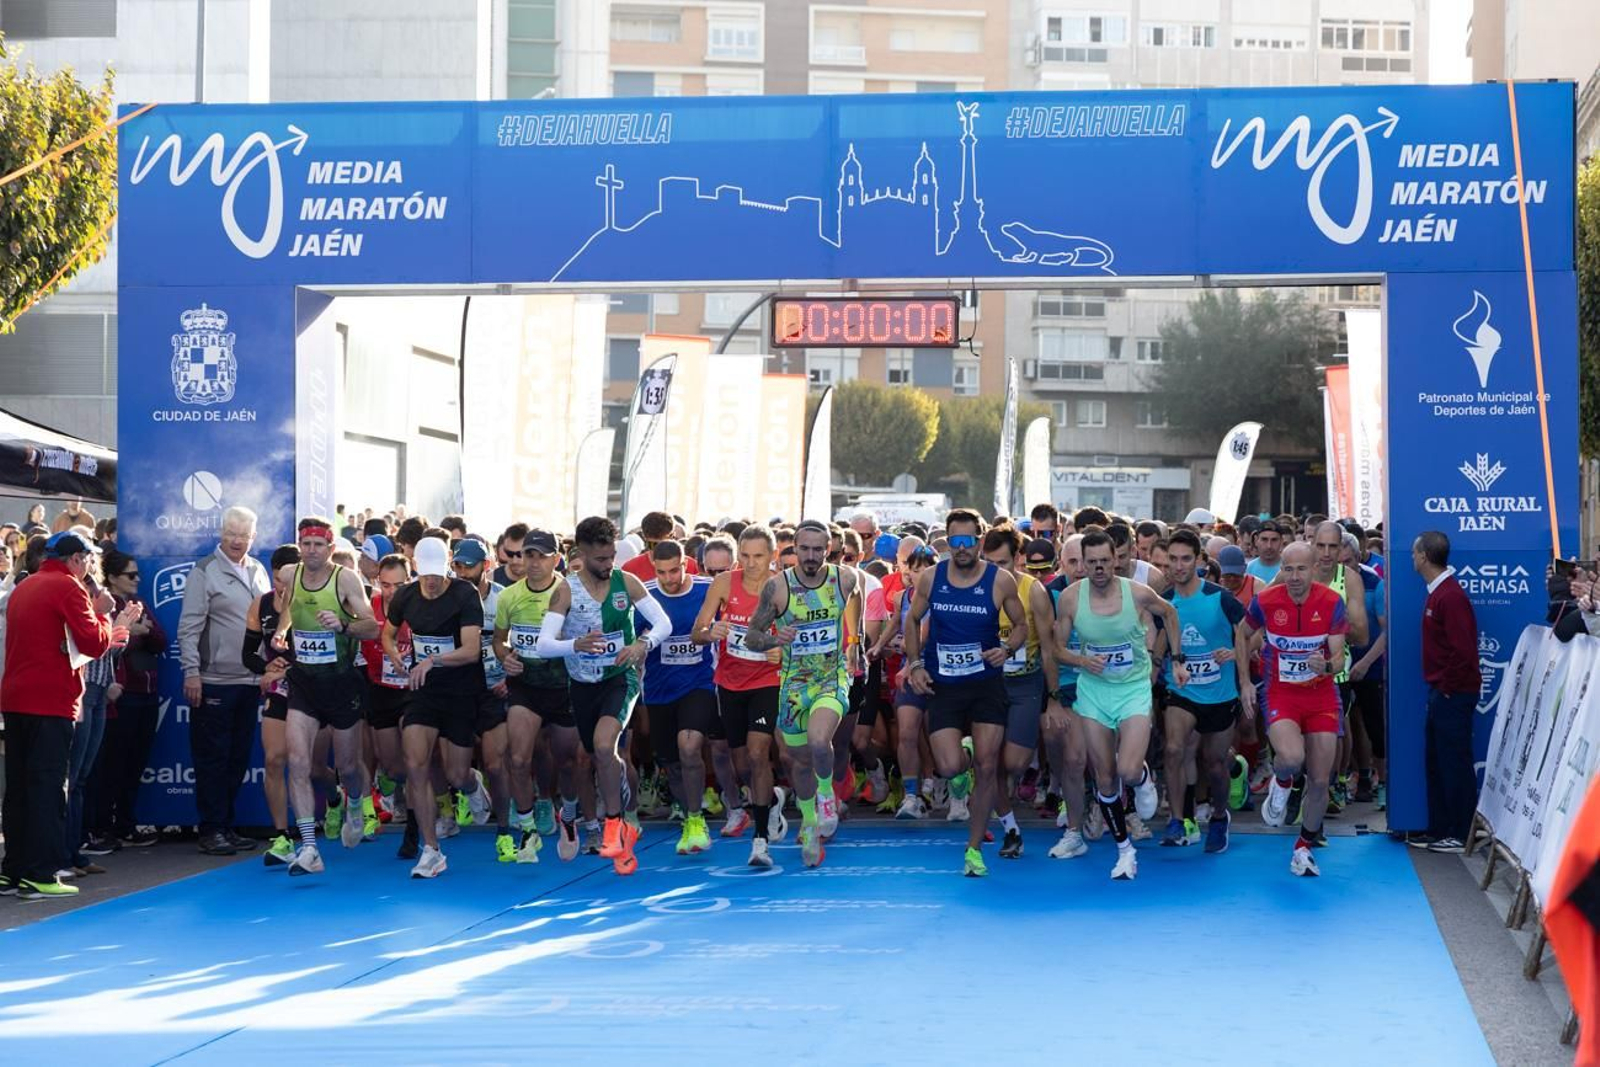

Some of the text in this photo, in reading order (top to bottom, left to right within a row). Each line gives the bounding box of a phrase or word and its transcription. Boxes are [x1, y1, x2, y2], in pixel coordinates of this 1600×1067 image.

[1005, 104, 1186, 138] #DEJAHUELLA
[497, 113, 673, 146] #DEJAHUELLA
[1397, 143, 1500, 168] MEDIA
[307, 160, 403, 185] MEDIA
[1390, 175, 1547, 206] MARATÓN
[299, 191, 447, 220] MARATÓN
[1378, 213, 1458, 243] JAÉN
[288, 228, 363, 257] JAÉN
[781, 303, 953, 342] 00:00:00
[1418, 392, 1474, 403] Patronato
[1477, 391, 1533, 404] Municipal
[153, 407, 257, 422] CIUDAD DE JAÉN
[1434, 404, 1536, 417] Deportes de Jaén
[1052, 471, 1151, 484] VITALDENT
[1425, 496, 1542, 513] CAJA RURAL
[1458, 514, 1506, 532] JAÉN
[932, 602, 988, 615] TROTASIERRA
[799, 629, 829, 643] 612
[300, 641, 327, 652] 444
[424, 645, 440, 656] 61
[669, 644, 697, 655] 988
[946, 652, 974, 665] 535
[1186, 662, 1212, 674] 472
[1288, 661, 1310, 671] 78
[166, 786, 194, 795] obras
